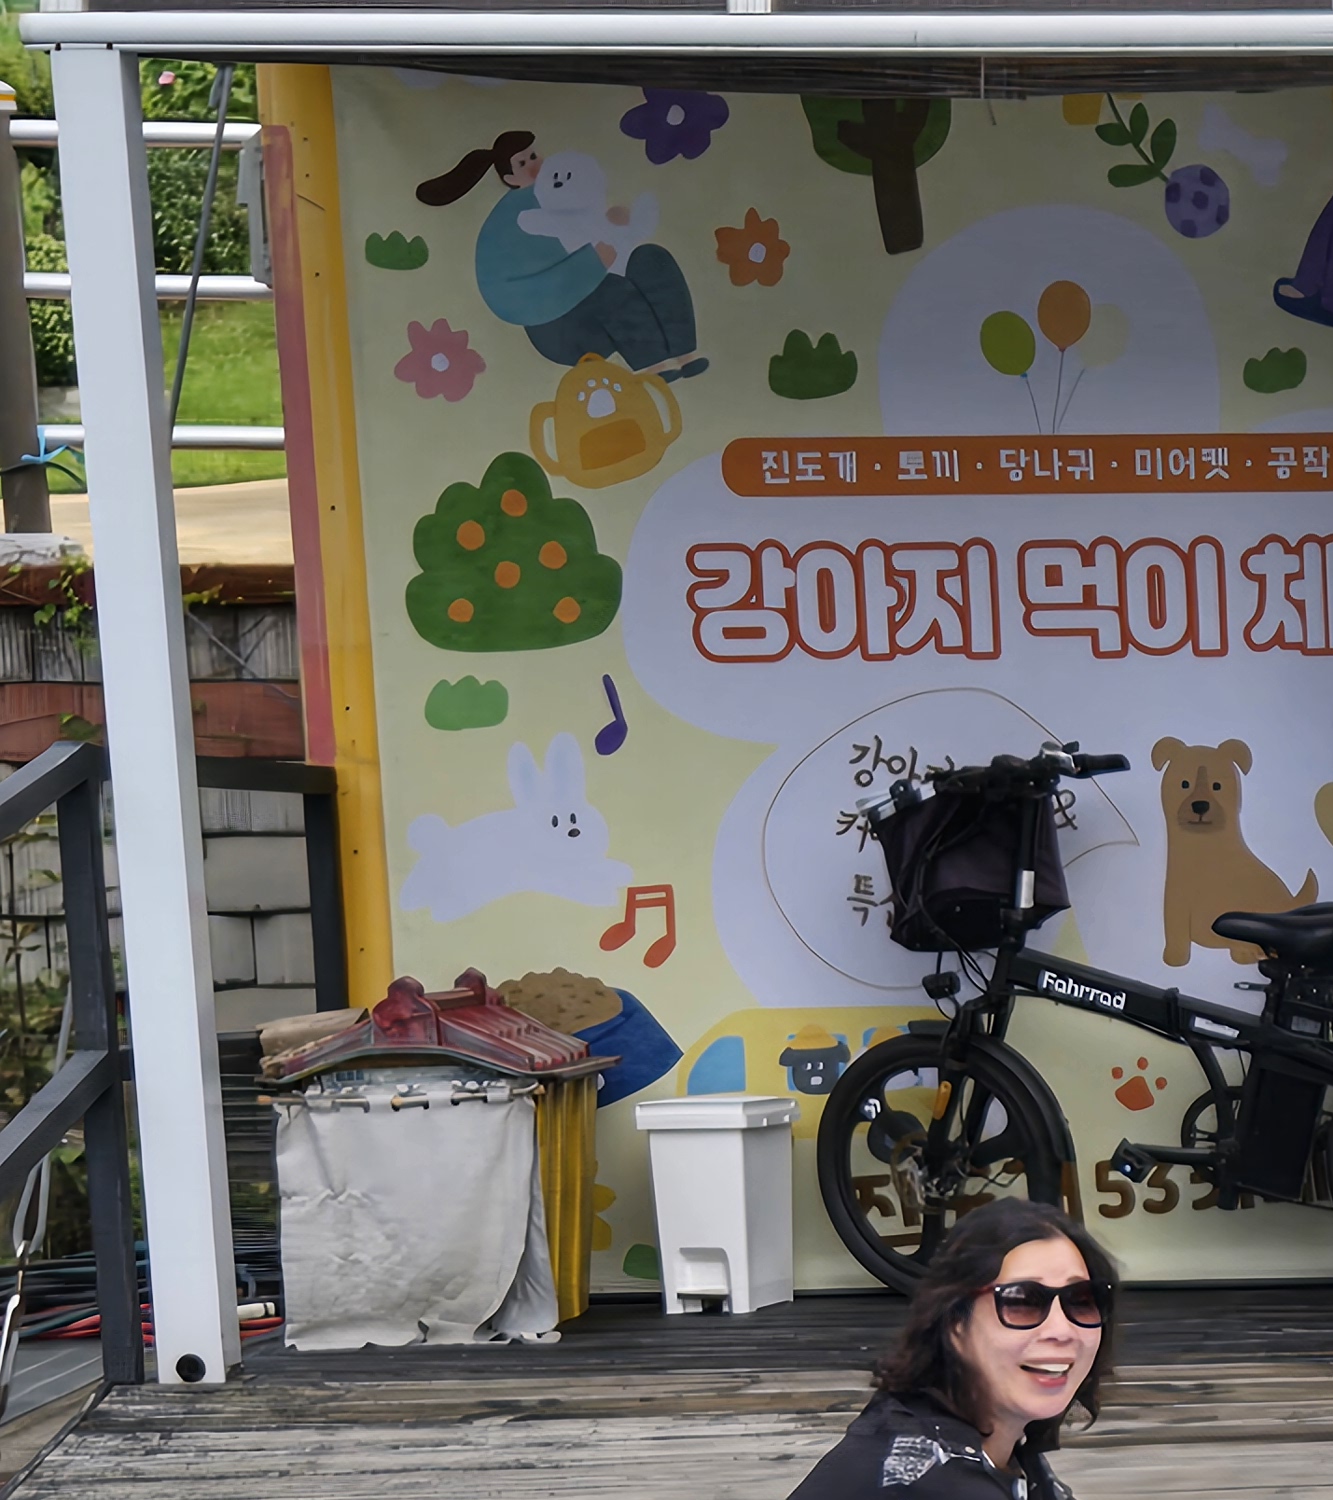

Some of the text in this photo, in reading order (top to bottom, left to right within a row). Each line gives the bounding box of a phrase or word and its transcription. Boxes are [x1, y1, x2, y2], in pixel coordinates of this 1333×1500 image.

[761, 448, 857, 484] 진도개
[897, 448, 960, 482] 토끼
[999, 447, 1095, 482] 당나귀
[685, 537, 1001, 663] 강아지
[1016, 535, 1229, 660] 먹이
[1041, 969, 1127, 1011] Fahrrad
